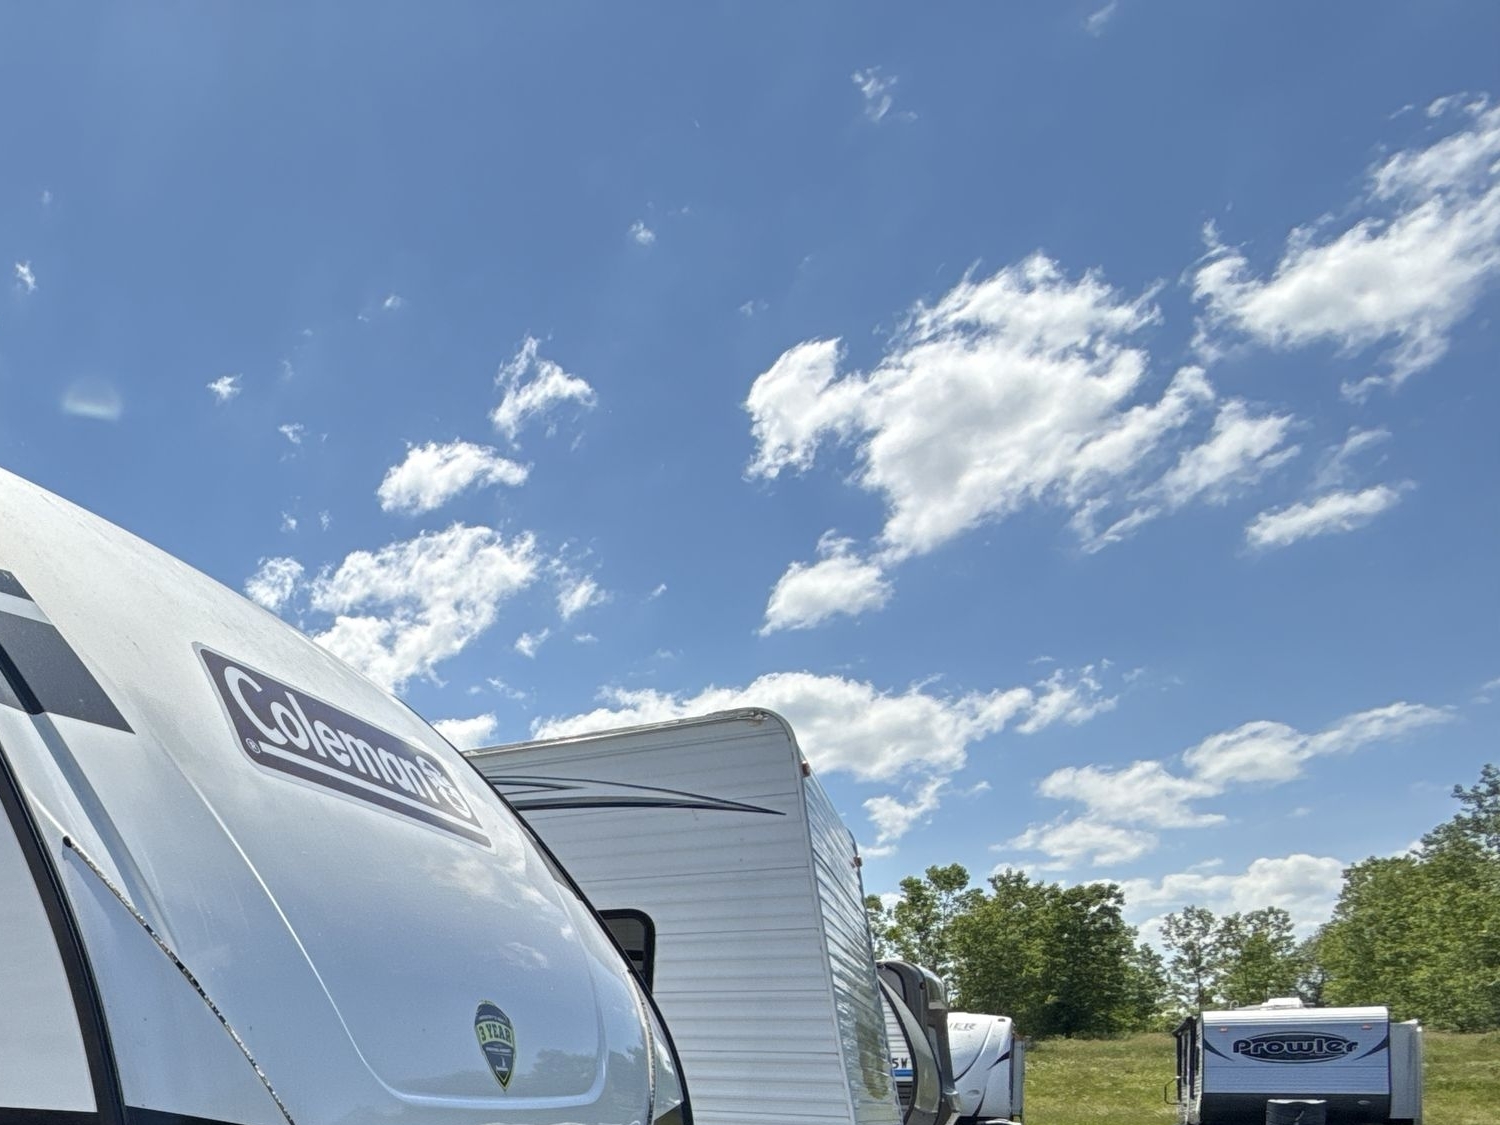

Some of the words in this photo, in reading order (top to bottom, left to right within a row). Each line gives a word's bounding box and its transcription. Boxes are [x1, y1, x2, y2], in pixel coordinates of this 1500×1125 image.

[223, 665, 440, 804] Coleman
[479, 1025, 487, 1042] 3
[486, 1023, 512, 1044] YEAR
[1232, 1038, 1359, 1055] Prowler
